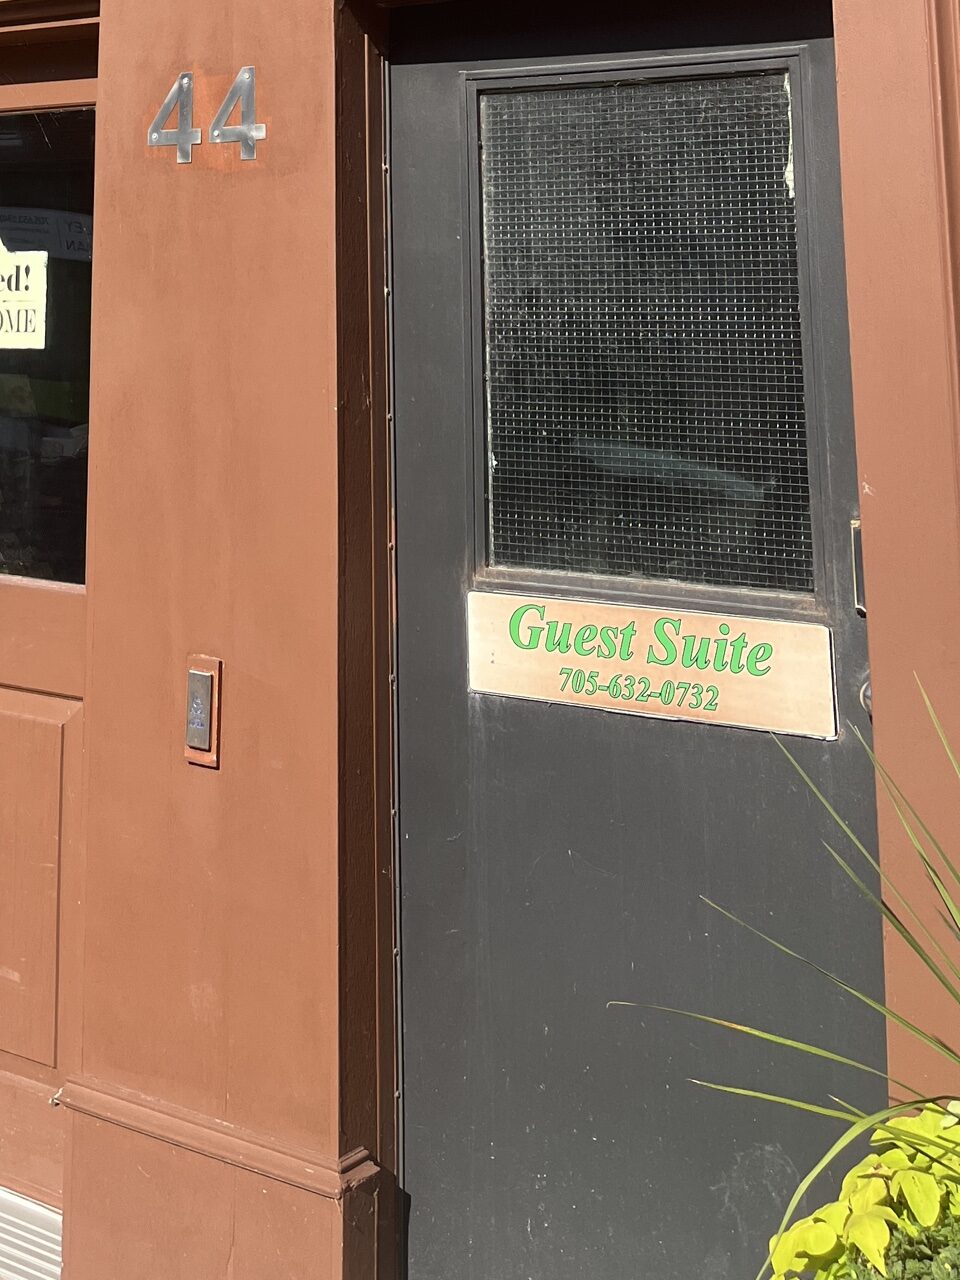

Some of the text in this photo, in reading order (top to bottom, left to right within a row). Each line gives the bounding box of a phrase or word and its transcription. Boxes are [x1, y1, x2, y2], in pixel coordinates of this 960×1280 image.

[147, 65, 267, 164] 44
[508, 603, 774, 677] Guest Suite
[558, 667, 720, 712] 705-632-0732
